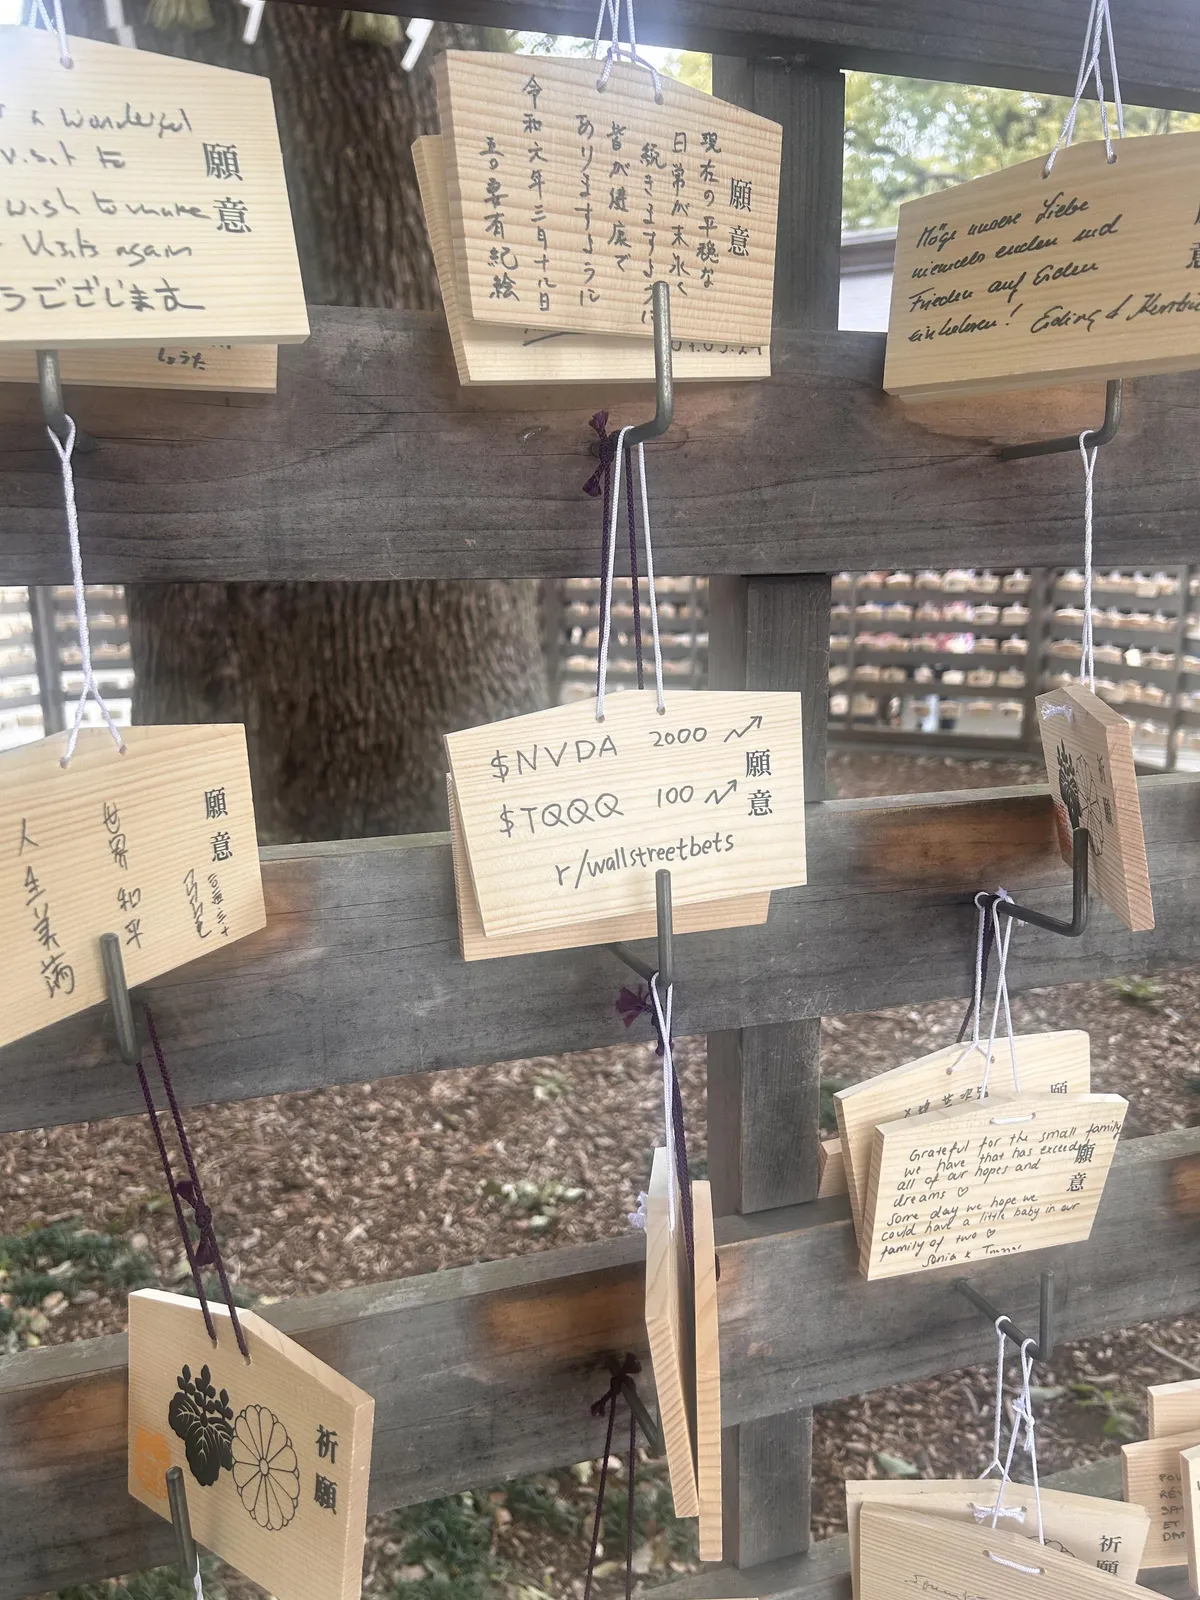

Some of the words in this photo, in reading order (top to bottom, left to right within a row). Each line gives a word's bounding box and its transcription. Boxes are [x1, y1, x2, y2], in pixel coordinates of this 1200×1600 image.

[202, 142, 252, 234] 願意
[574, 114, 600, 307] ありますように
[727, 176, 752, 257] 願意
[1072, 214, 1123, 242] und
[908, 287, 974, 313] Frieden
[987, 271, 1027, 303] auf
[1032, 262, 1099, 286] Erden
[490, 735, 618, 782] $NVDA
[648, 727, 708, 747] 2000
[746, 749, 773, 817] 願意
[204, 786, 233, 862] 願意
[499, 793, 624, 837] $TQQQ
[657, 785, 694, 808] 100
[554, 832, 735, 888] r/wallstreetbets
[904, 1166, 921, 1178] we
[936, 1158, 965, 1172] have
[979, 1152, 1004, 1165] that
[1012, 1147, 1033, 1159] has
[909, 1140, 970, 1162] Grateful
[978, 1136, 1001, 1157] for
[1010, 1131, 1028, 1146] the
[1038, 1127, 1076, 1143] small
[1086, 1120, 1122, 1140] family
[893, 1190, 946, 1208] dreams
[896, 1178, 915, 1191] all
[924, 1172, 940, 1190] of
[948, 1170, 968, 1181] our
[974, 1165, 1008, 1184] hopes
[1015, 1158, 1041, 1172] and
[881, 1223, 917, 1242] could
[925, 1218, 953, 1234] have
[963, 1218, 971, 1227] a
[979, 1211, 1005, 1223] little
[1013, 1206, 1040, 1222] baby
[1045, 1203, 1056, 1214] in
[1060, 1202, 1081, 1212] our
[930, 1205, 959, 1222] day
[966, 1203, 983, 1213] we
[990, 1196, 1017, 1214] hope
[1022, 1194, 1038, 1202] we
[879, 1240, 925, 1262] family
[929, 1236, 945, 1253] of
[955, 1232, 977, 1244] two
[314, 1424, 339, 1515] 祈願
